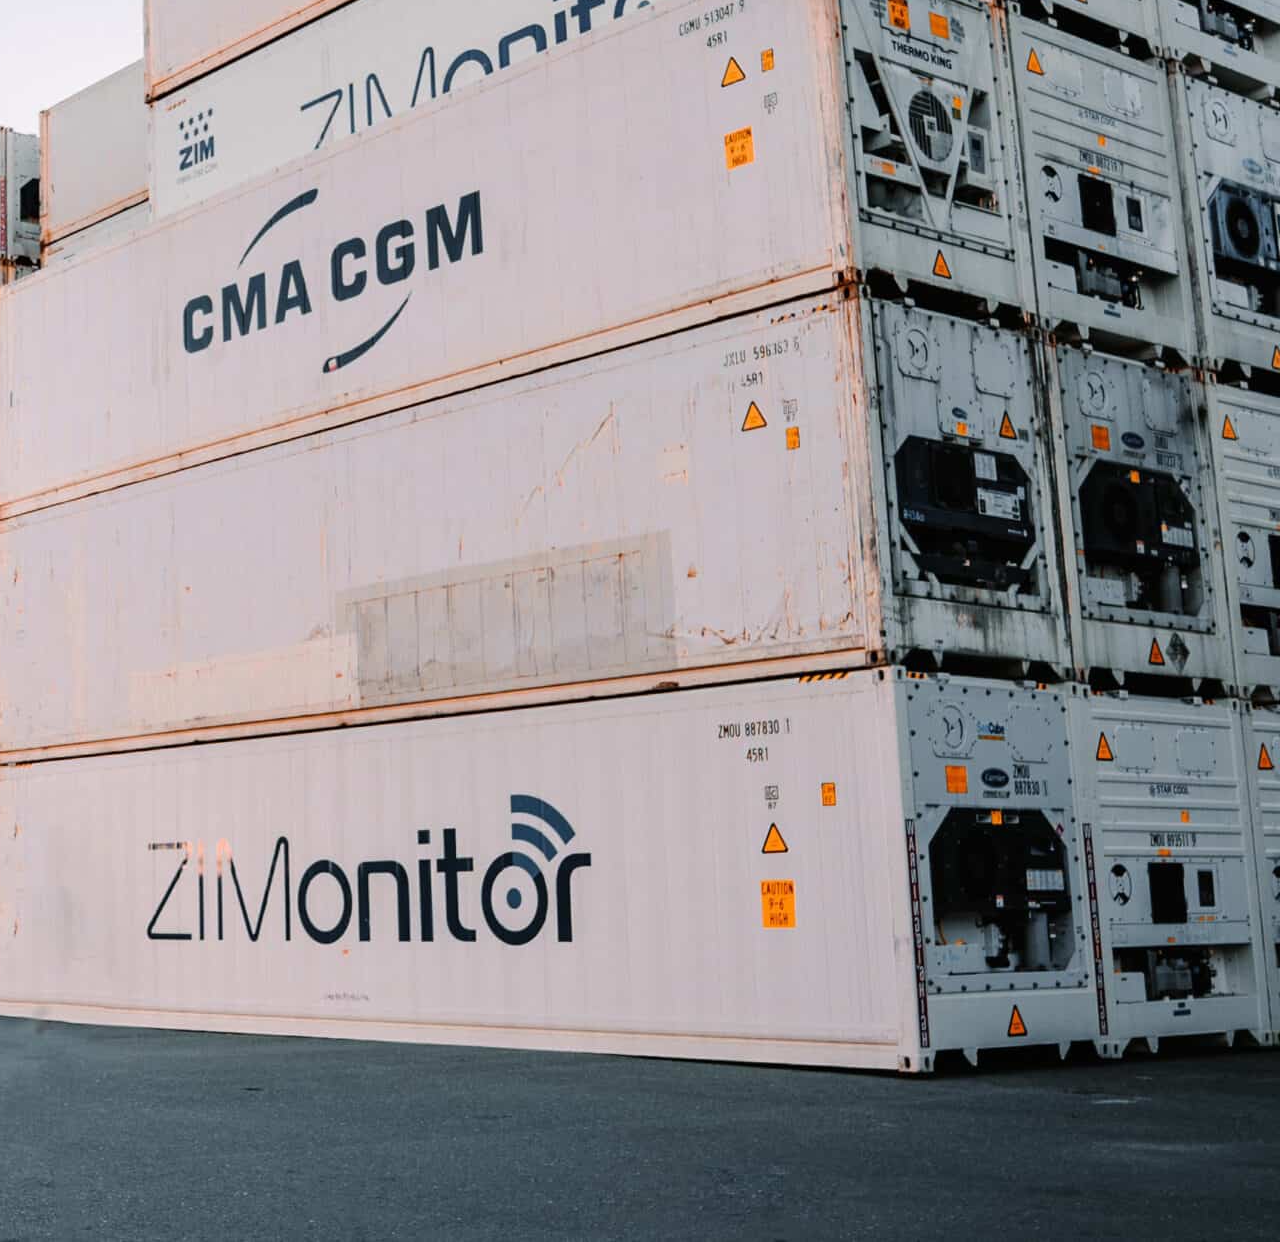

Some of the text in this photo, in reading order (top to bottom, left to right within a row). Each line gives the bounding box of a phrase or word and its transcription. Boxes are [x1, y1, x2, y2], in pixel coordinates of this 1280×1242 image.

[678, 19, 701, 37] CGMU
[706, 30, 728, 49] 45R1
[891, 39, 953, 70] THERMO KING
[179, 135, 215, 171] ZIM
[183, 190, 484, 353] CMA CGM
[718, 724, 741, 739] ZMOU
[744, 719, 780, 737] 887830
[746, 748, 769, 763] 45R1
[761, 881, 794, 895] CAUTION
[770, 912, 789, 926] HIGH
